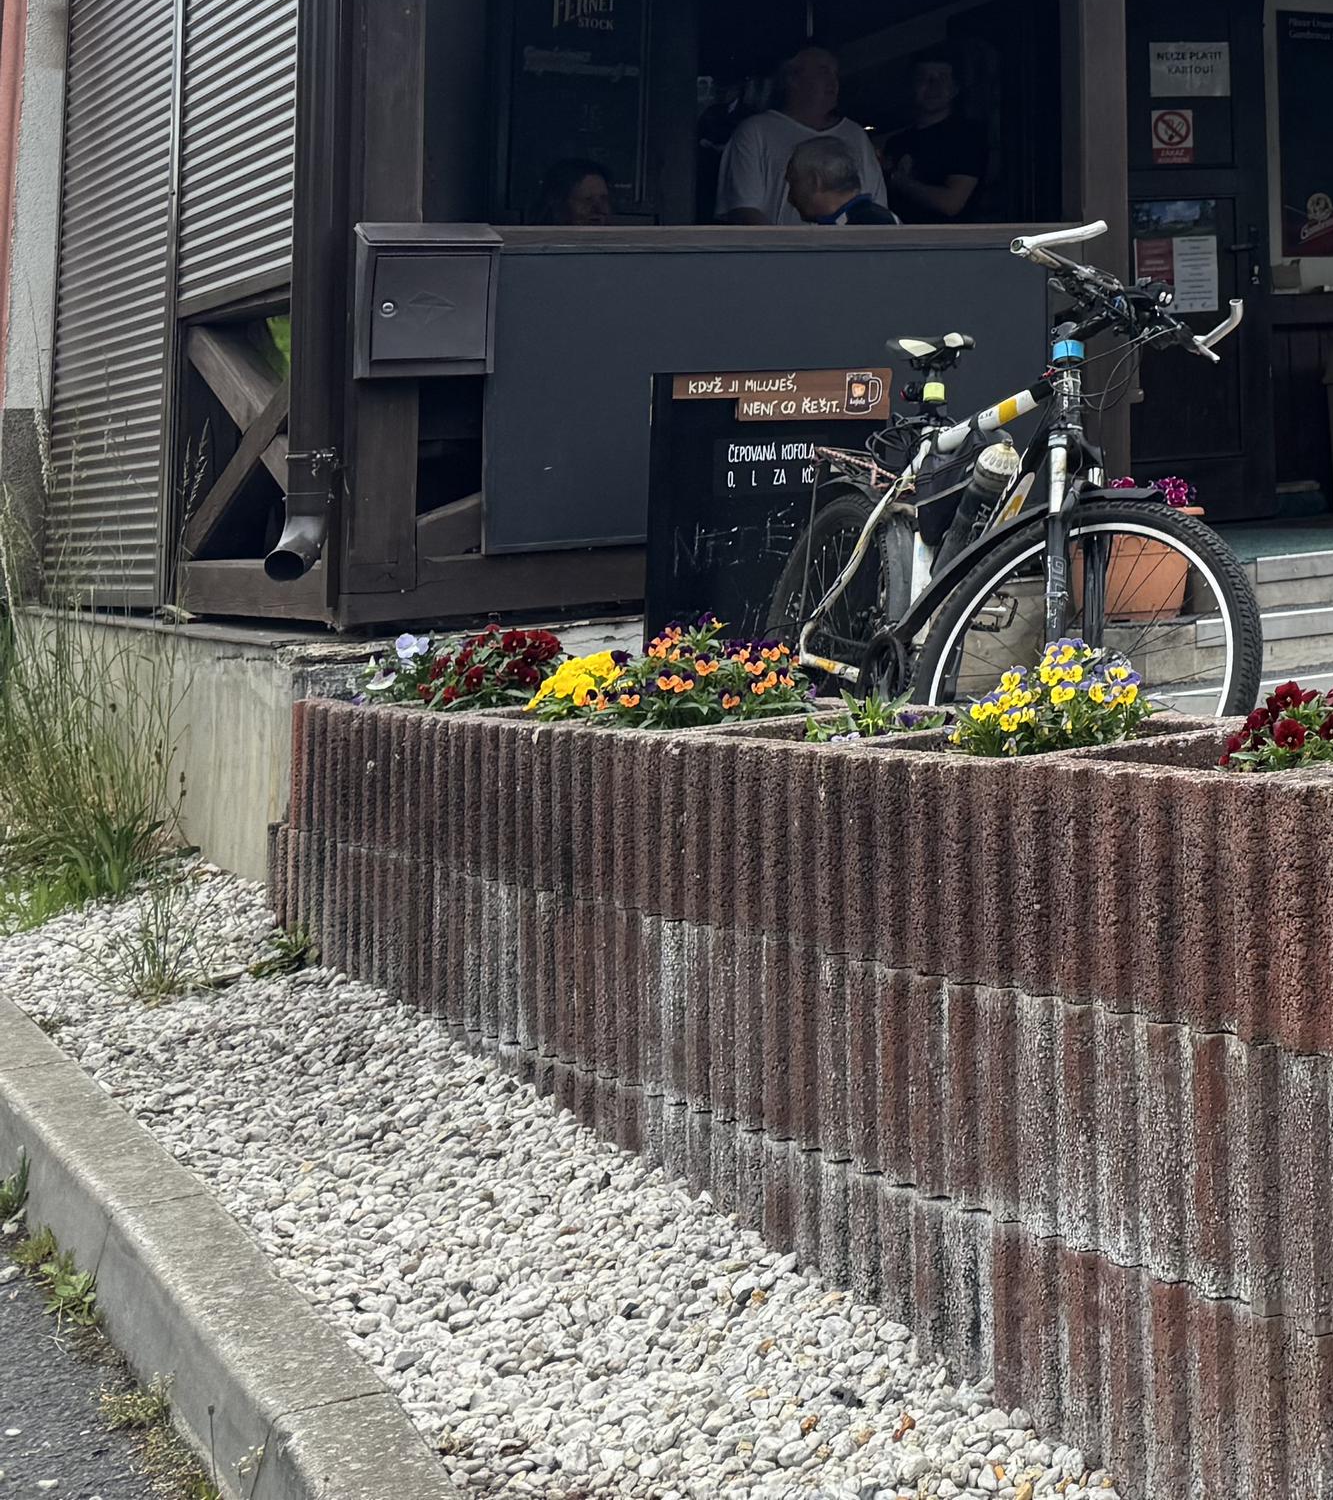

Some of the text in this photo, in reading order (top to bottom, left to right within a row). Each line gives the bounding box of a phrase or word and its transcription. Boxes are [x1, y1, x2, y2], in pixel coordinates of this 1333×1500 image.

[577, 17, 614, 31] STOCK
[688, 372, 798, 394] KDYŽ JI MILUJEŠ,
[743, 397, 840, 416] NENÍ CO ŘEŠIT.
[728, 443, 815, 463] ČEPOVANÁ KOFOLA
[751, 471, 757, 486] L
[773, 469, 786, 485] ZA
[802, 465, 815, 484] KČ
